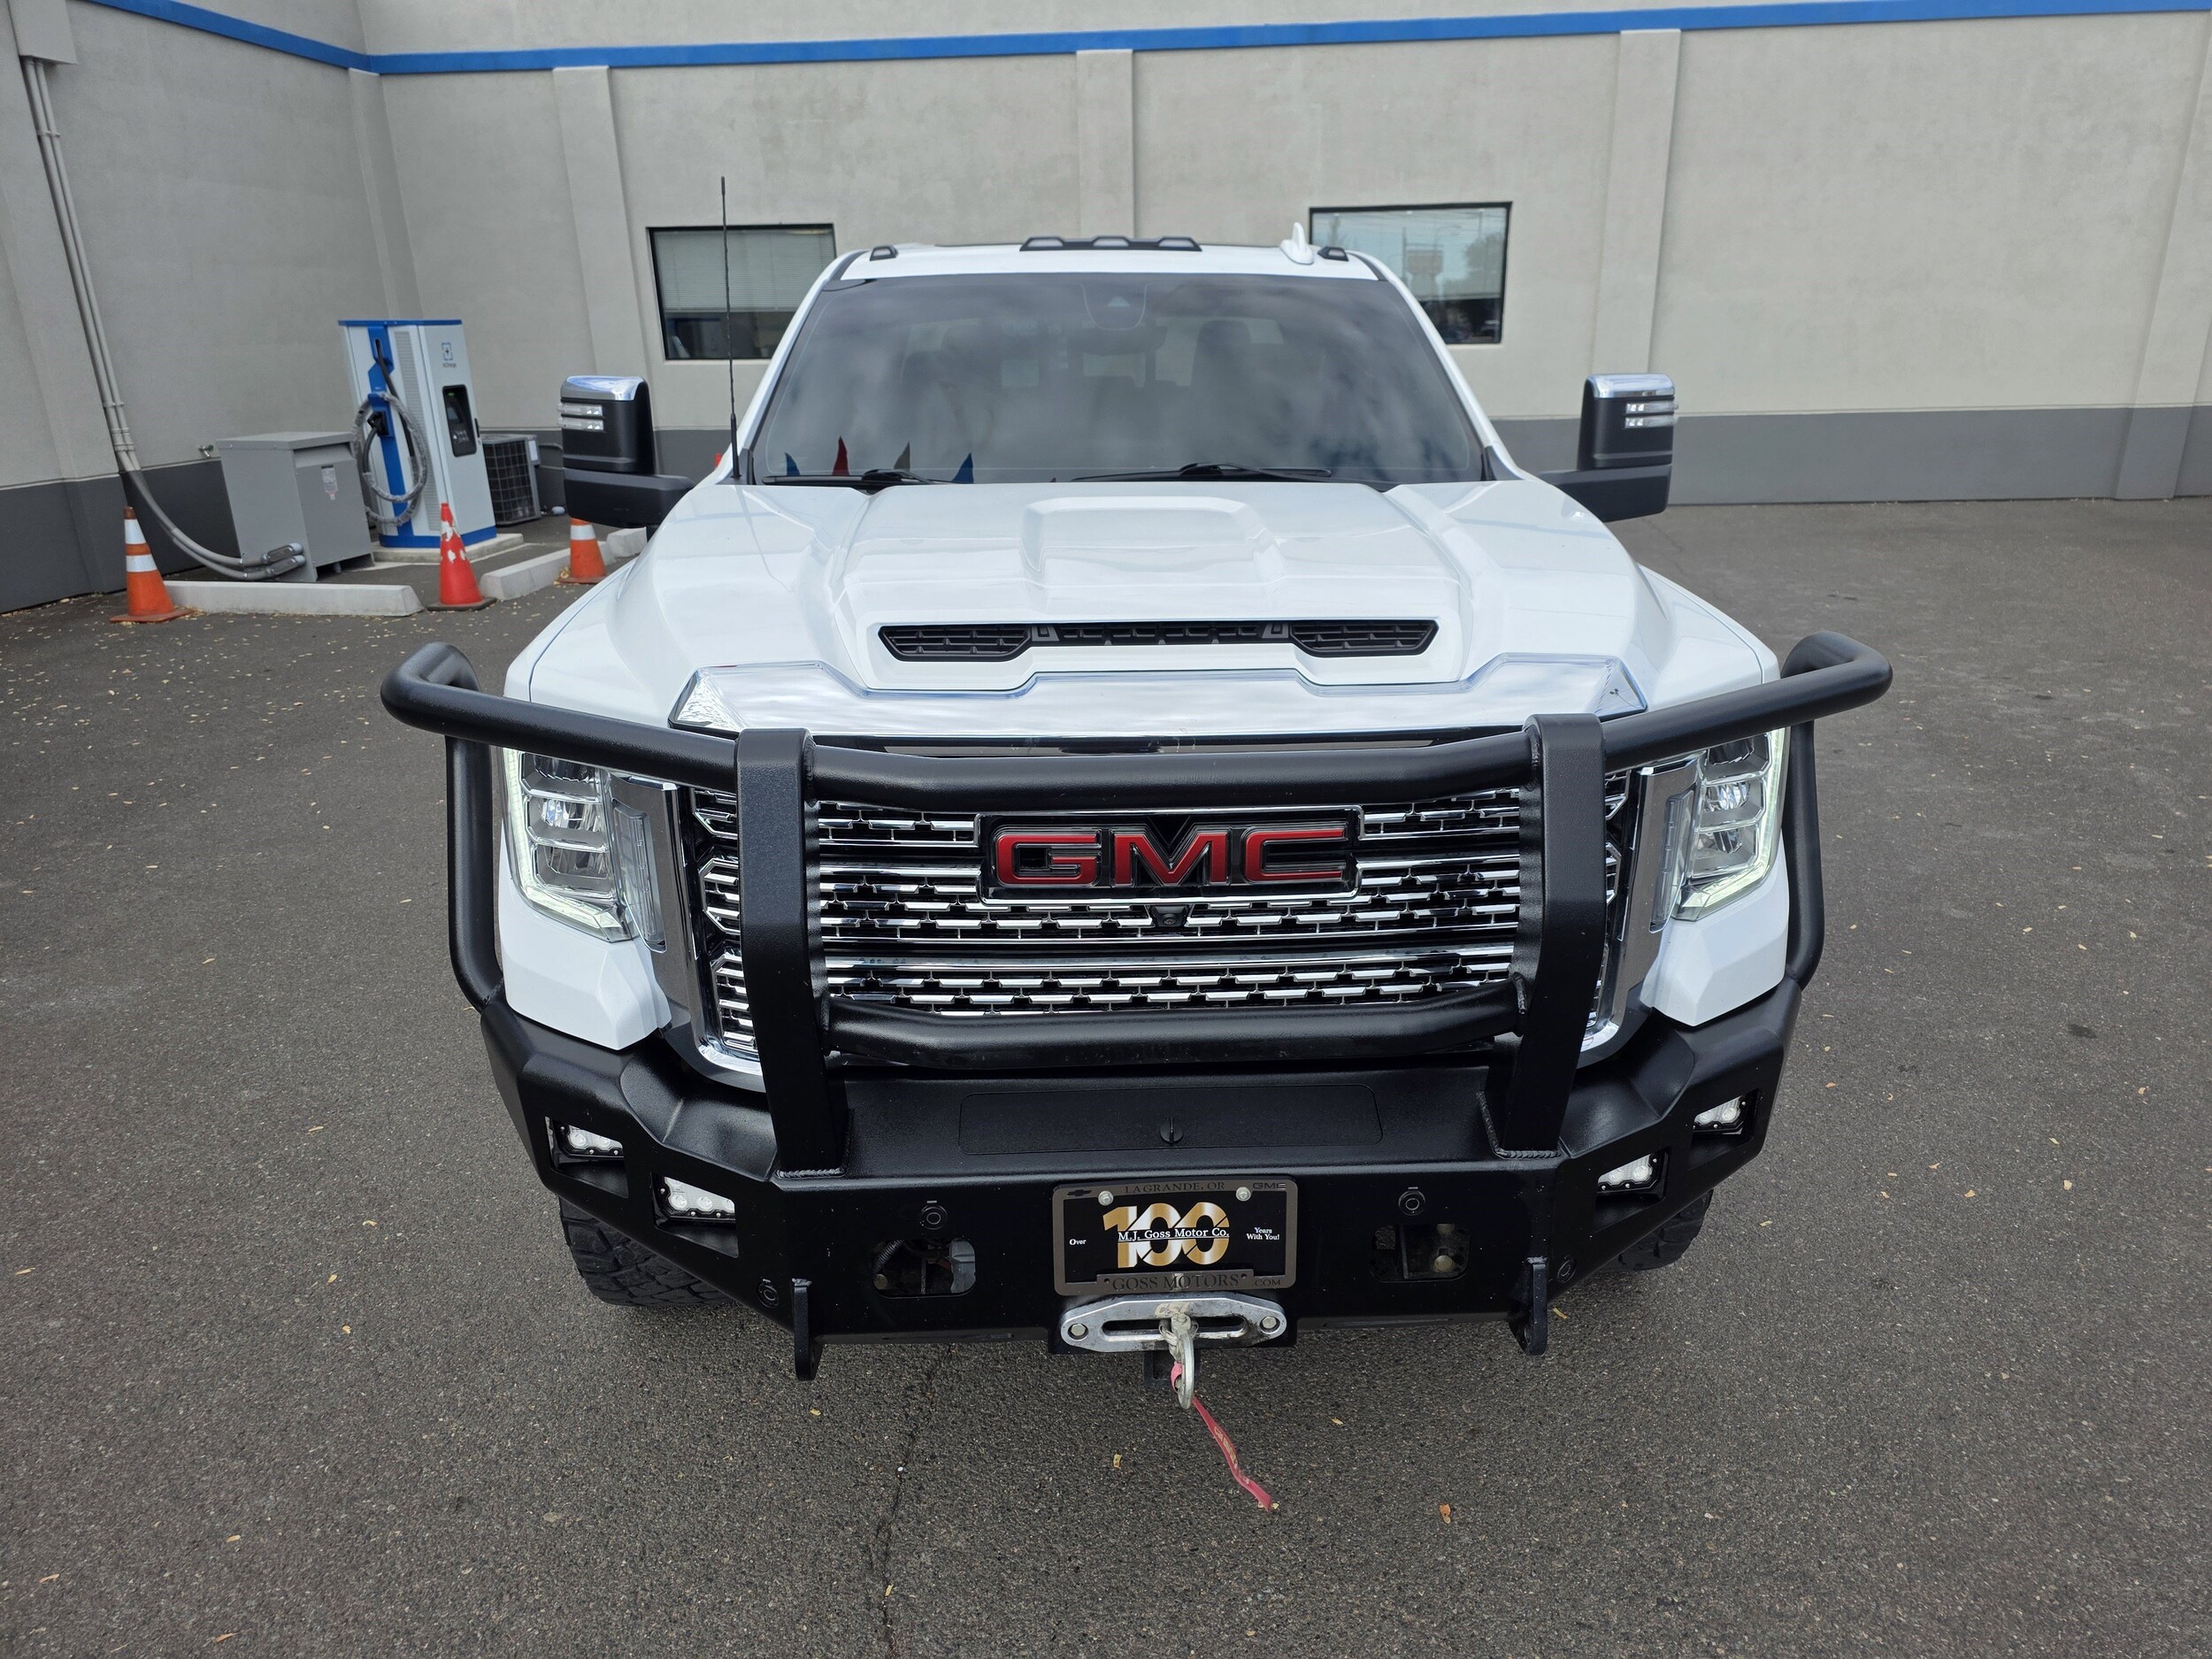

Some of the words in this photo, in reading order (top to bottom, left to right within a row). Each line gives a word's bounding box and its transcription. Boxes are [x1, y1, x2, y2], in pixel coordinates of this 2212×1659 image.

[996, 829, 1344, 886] GMC
[1207, 1182, 1225, 1191] OR
[1102, 1202, 1230, 1268] 100
[1118, 1231, 1141, 1241] M.J.
[1144, 1230, 1171, 1239] Goss
[1174, 1228, 1209, 1237] Motor
[1211, 1227, 1230, 1237] Co.
[1112, 1277, 1158, 1291] GOSS
[1164, 1273, 1239, 1290] MOTORS
